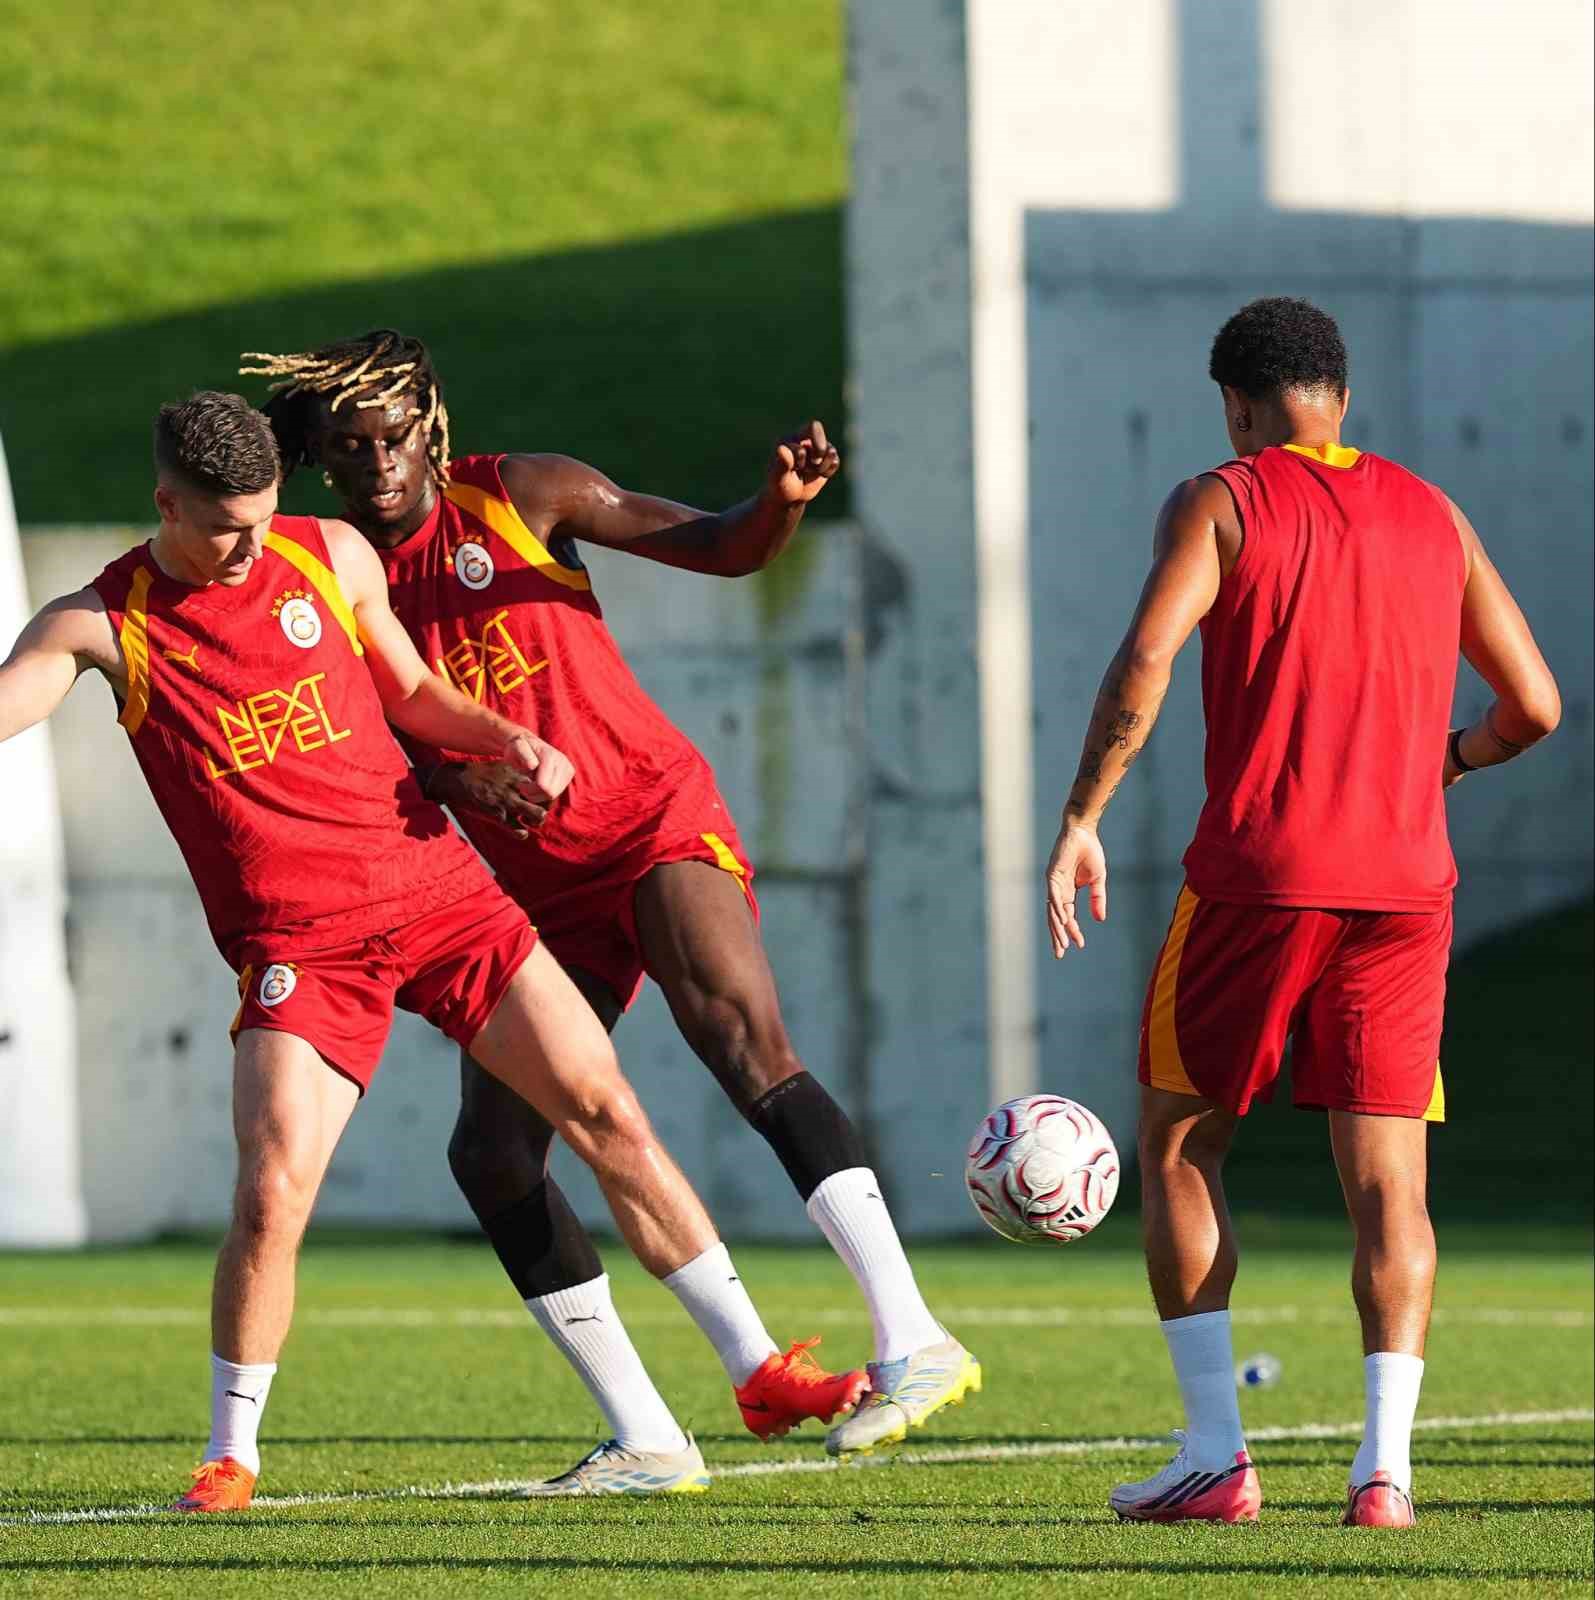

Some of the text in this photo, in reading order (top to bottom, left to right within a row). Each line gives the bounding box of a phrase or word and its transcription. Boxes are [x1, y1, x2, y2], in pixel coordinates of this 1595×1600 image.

[215, 671, 326, 740] NEXT
[460, 644, 550, 704] VEL
[203, 708, 352, 779] LEVEL
